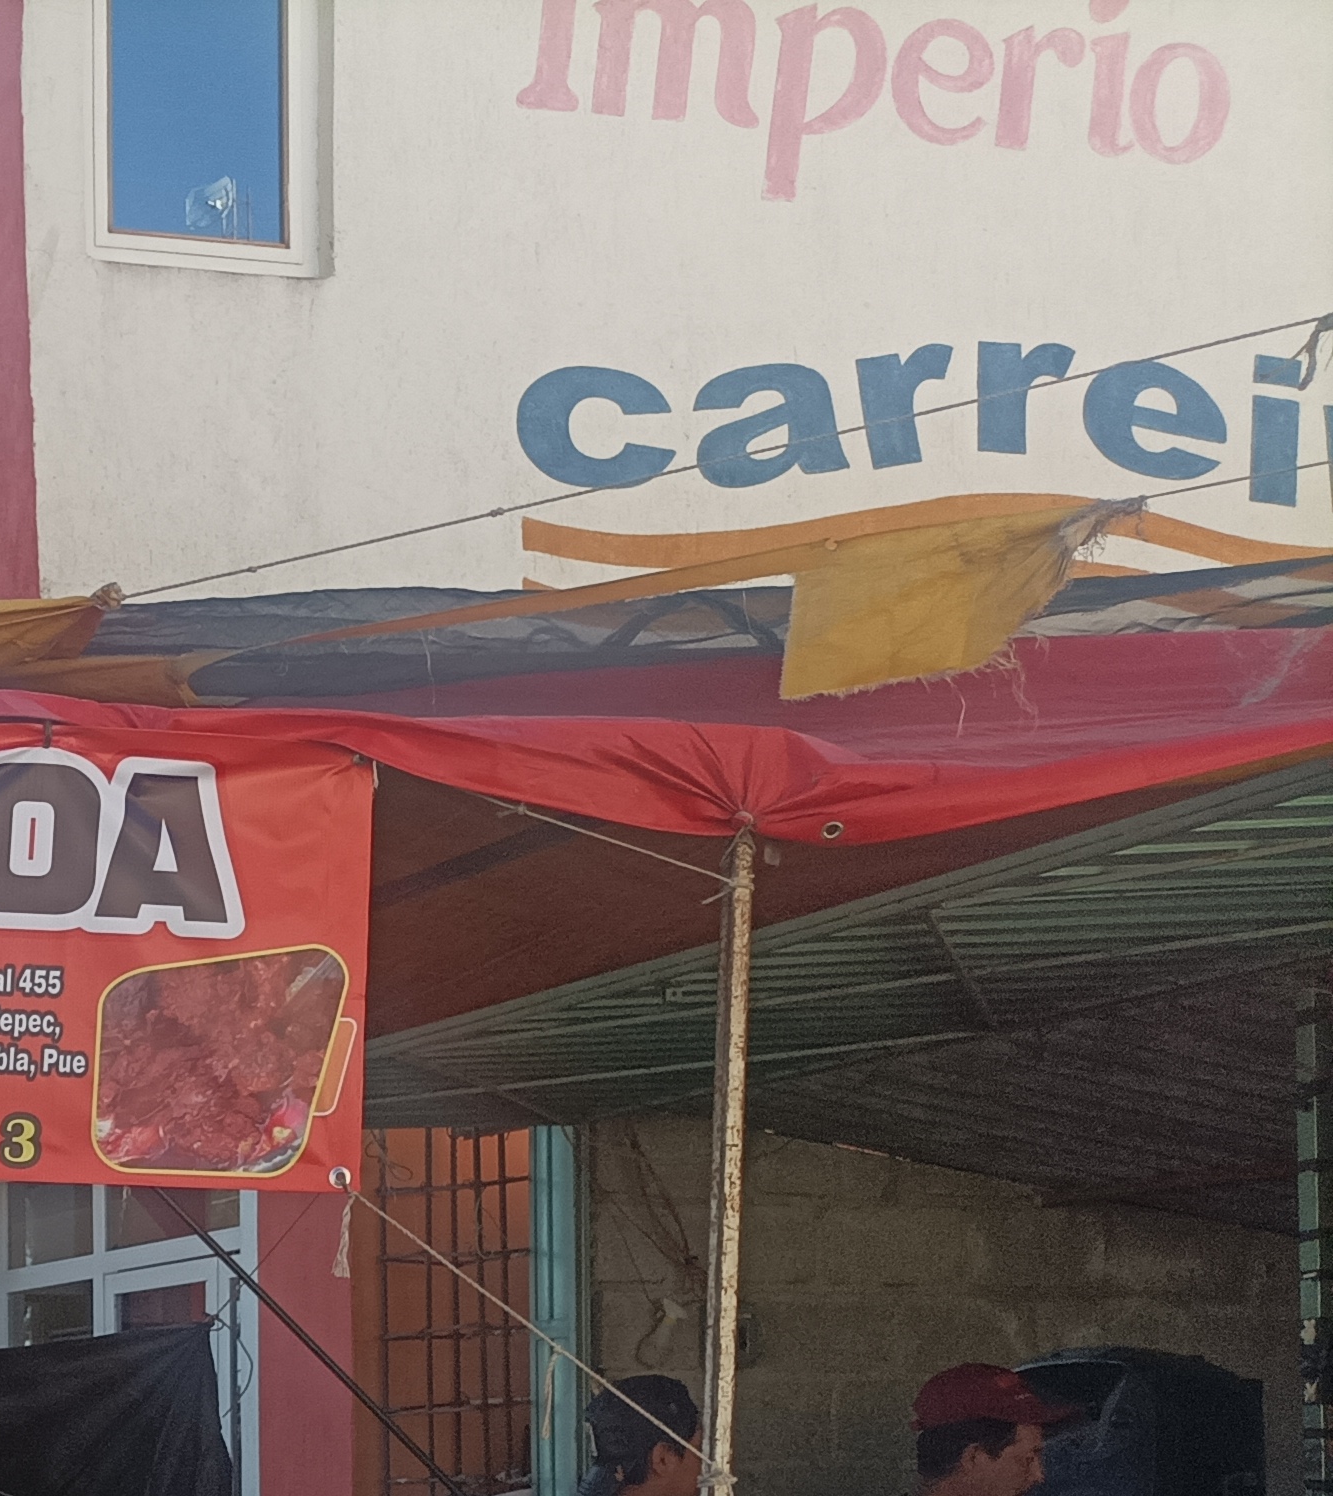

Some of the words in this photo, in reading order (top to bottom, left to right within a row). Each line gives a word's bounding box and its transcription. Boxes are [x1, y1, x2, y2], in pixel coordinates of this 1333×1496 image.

[516, 0, 1230, 202] Imperio
[516, 341, 1333, 508] carrei
[18, 968, 62, 995] 455
[41, 1047, 88, 1076] Pue
